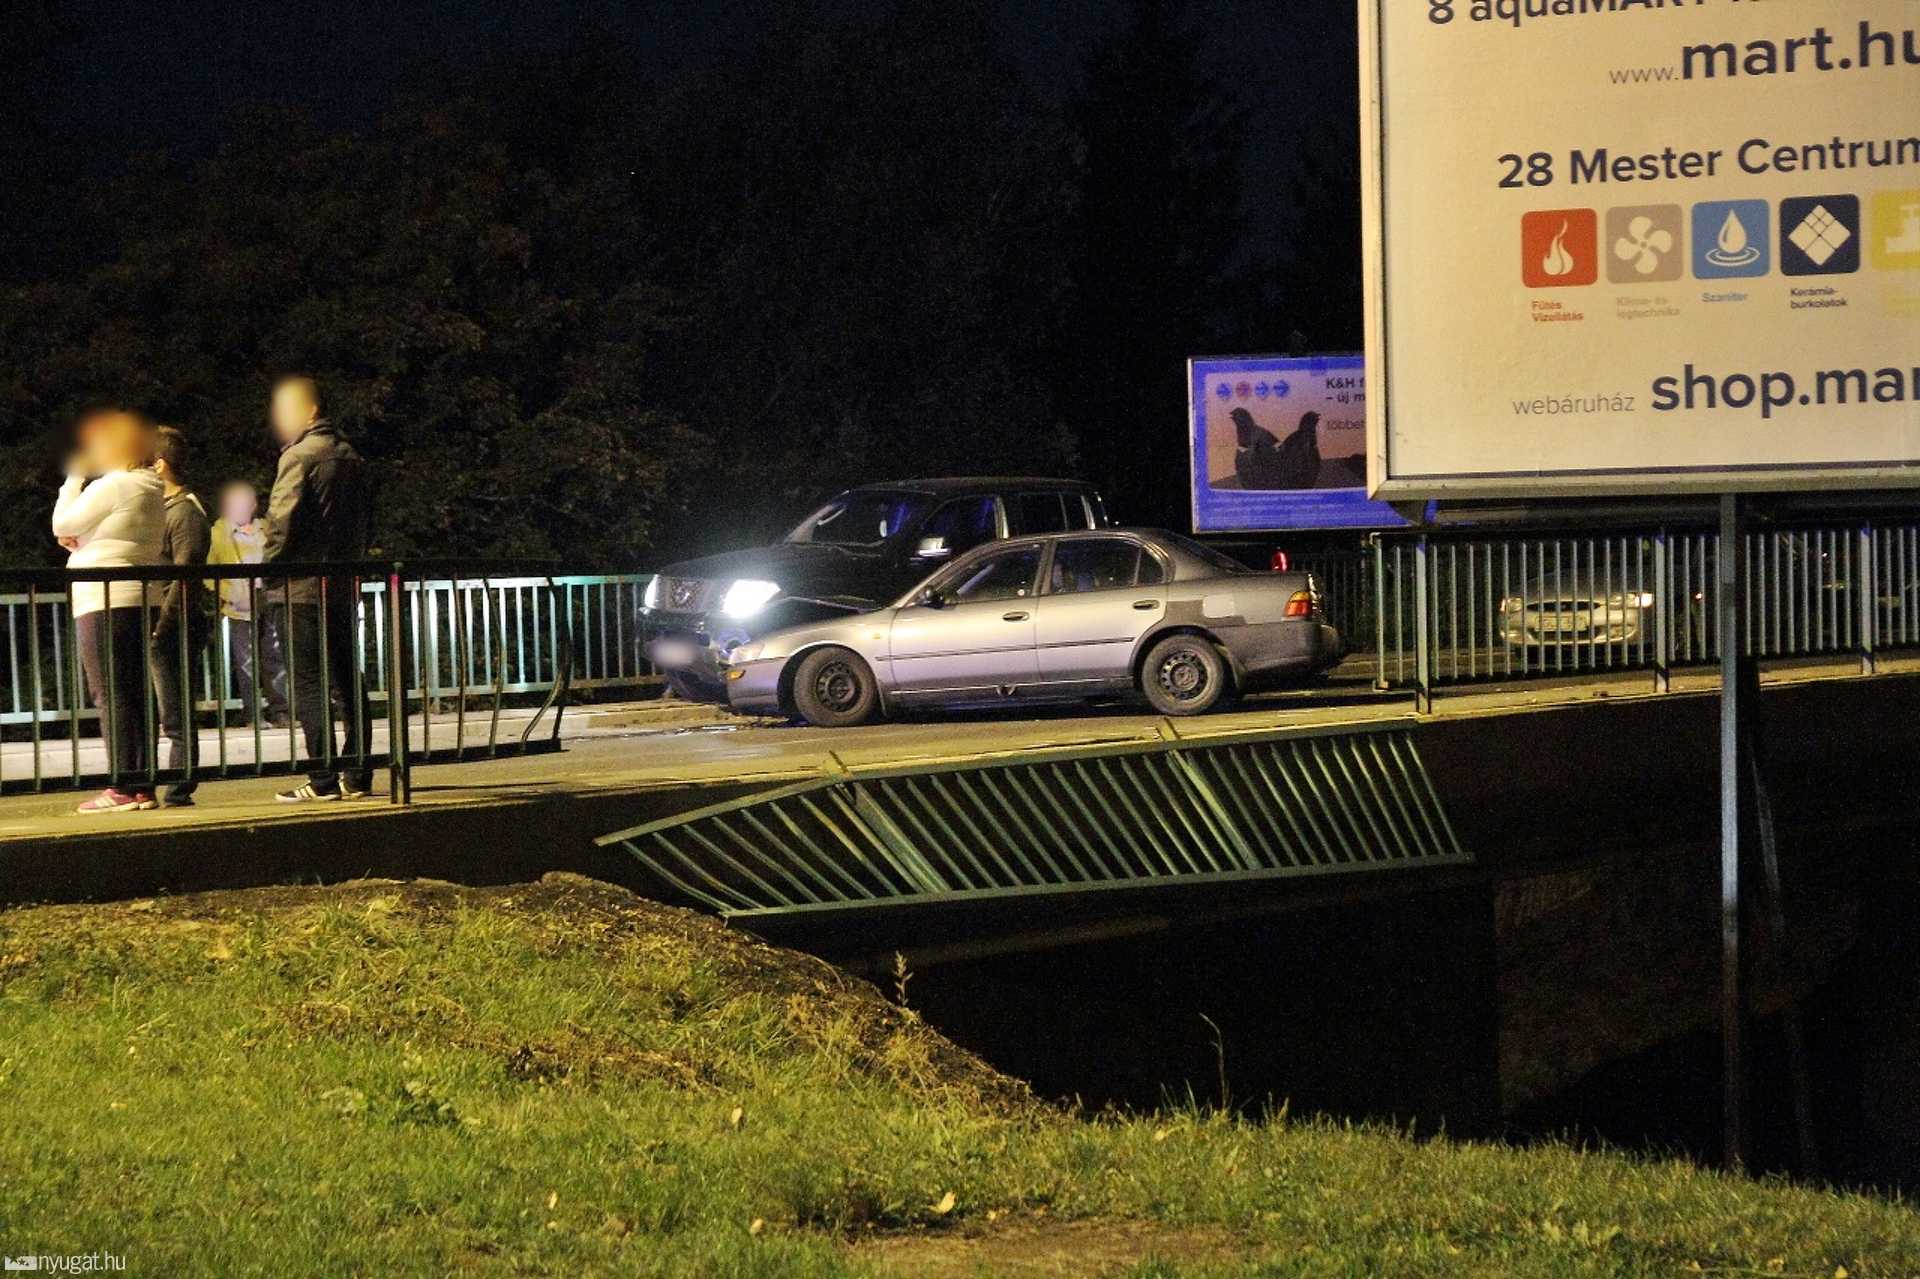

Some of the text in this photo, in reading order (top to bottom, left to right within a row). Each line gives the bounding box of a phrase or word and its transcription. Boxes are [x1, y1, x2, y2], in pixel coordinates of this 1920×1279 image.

[1609, 20, 1920, 85] www.mart.hu
[1498, 151, 1553, 188] 28
[1570, 145, 1722, 185] Mester
[1326, 377, 1355, 389] K&H
[1512, 392, 1635, 415] webáruház
